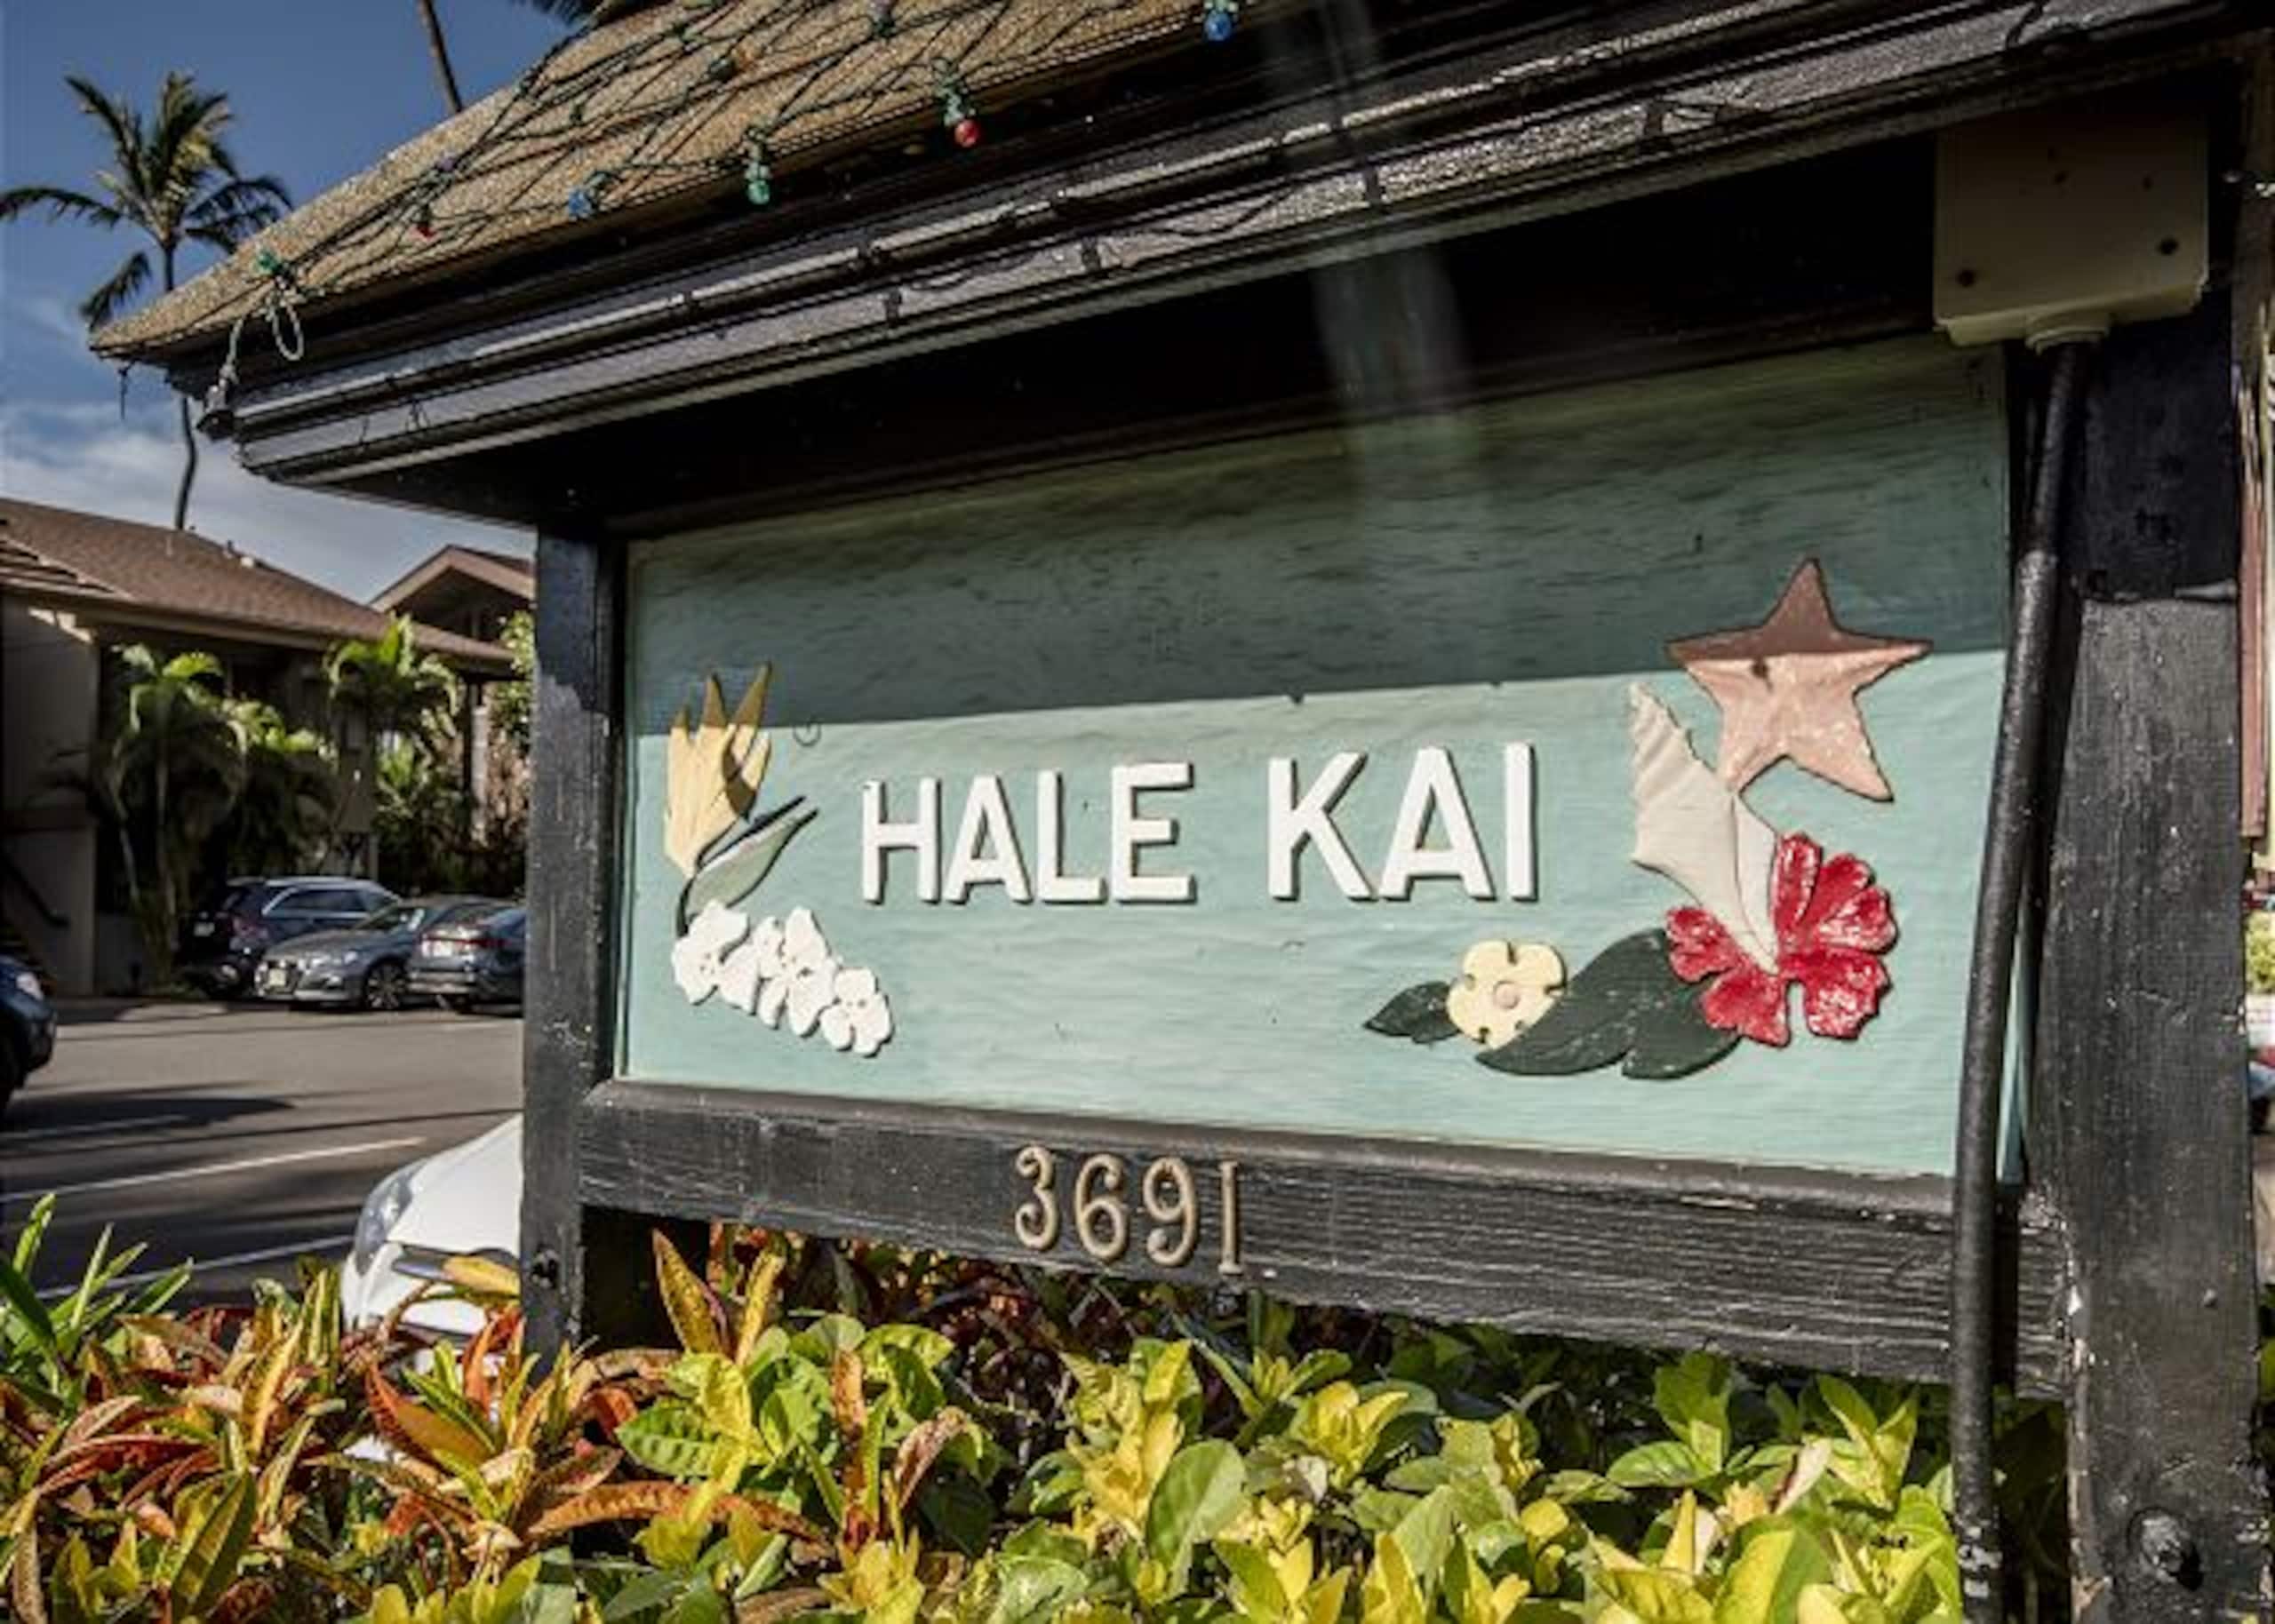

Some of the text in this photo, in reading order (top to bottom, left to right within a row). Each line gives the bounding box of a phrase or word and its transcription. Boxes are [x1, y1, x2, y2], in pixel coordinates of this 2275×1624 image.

[862, 743, 1537, 904] HALE KAI
[1015, 1145, 1241, 1274] 3691
